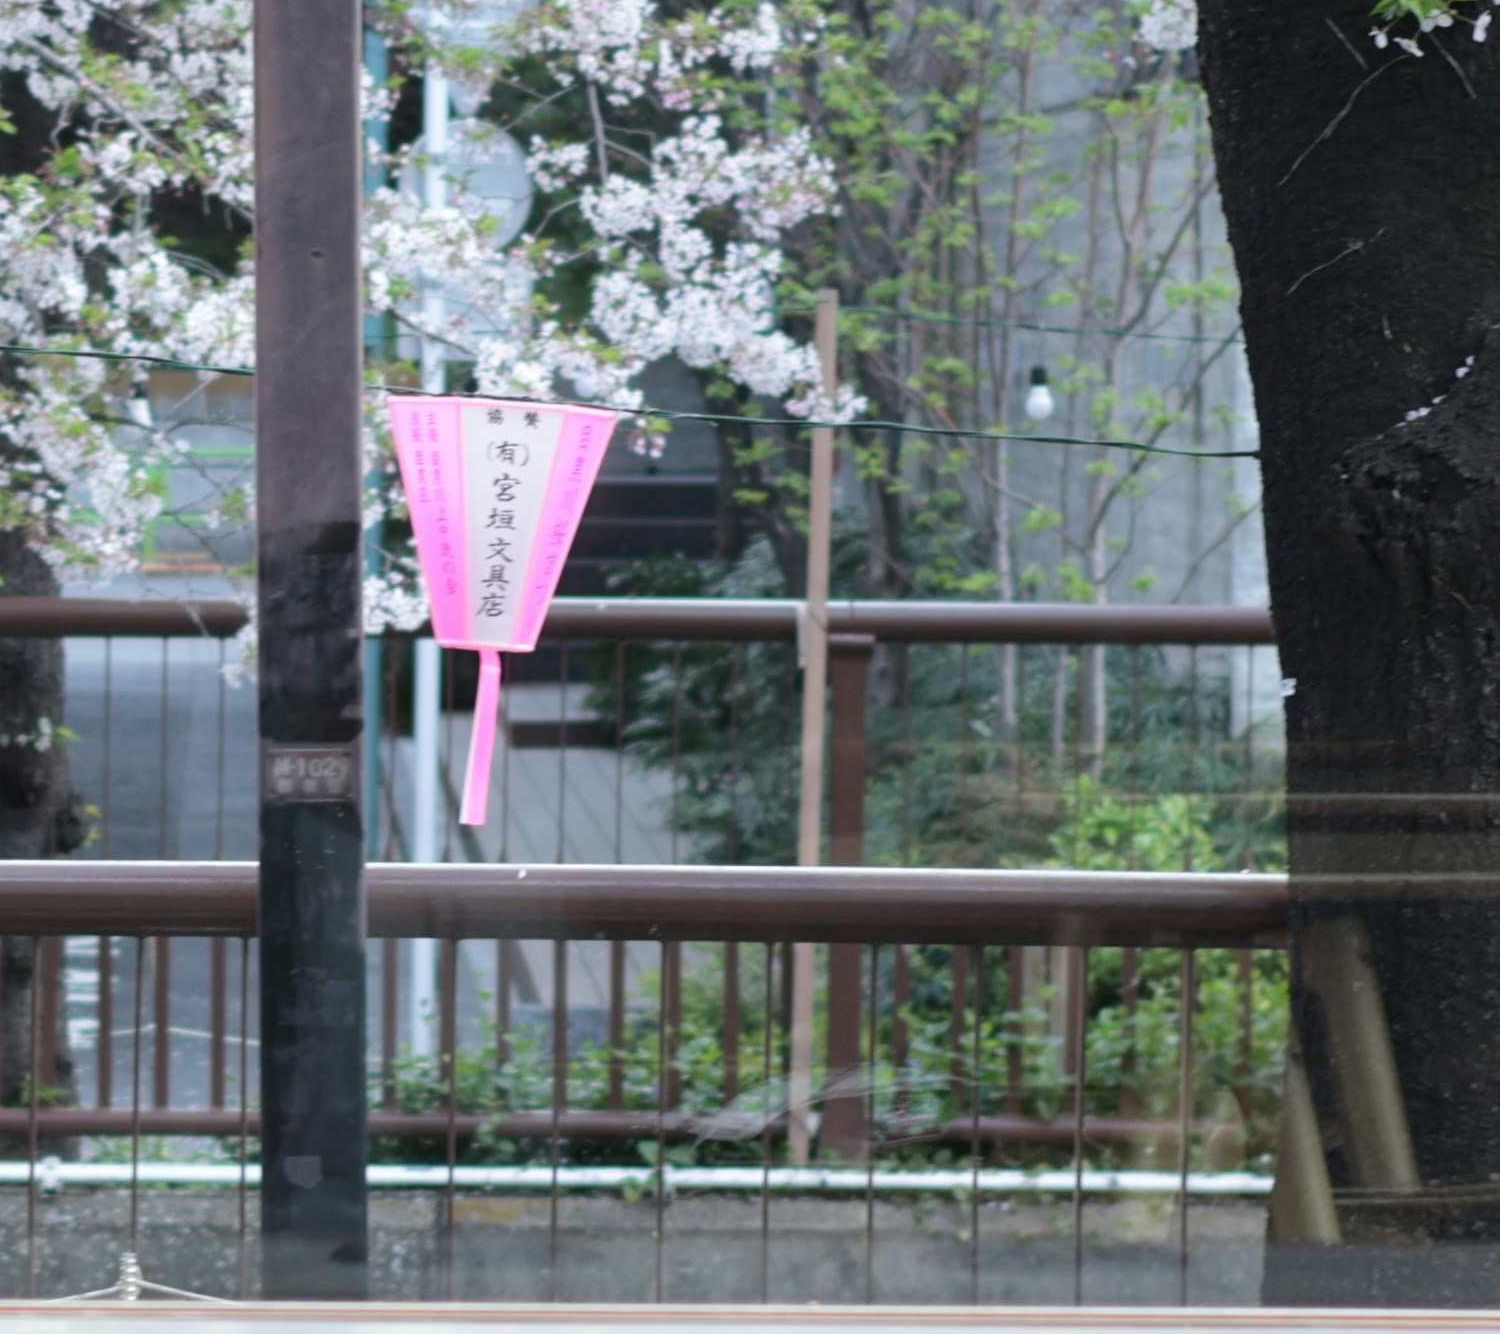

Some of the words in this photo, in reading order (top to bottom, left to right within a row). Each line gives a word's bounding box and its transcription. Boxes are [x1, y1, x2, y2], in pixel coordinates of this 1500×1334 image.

[475, 440, 532, 618] (有)宮垣文具店
